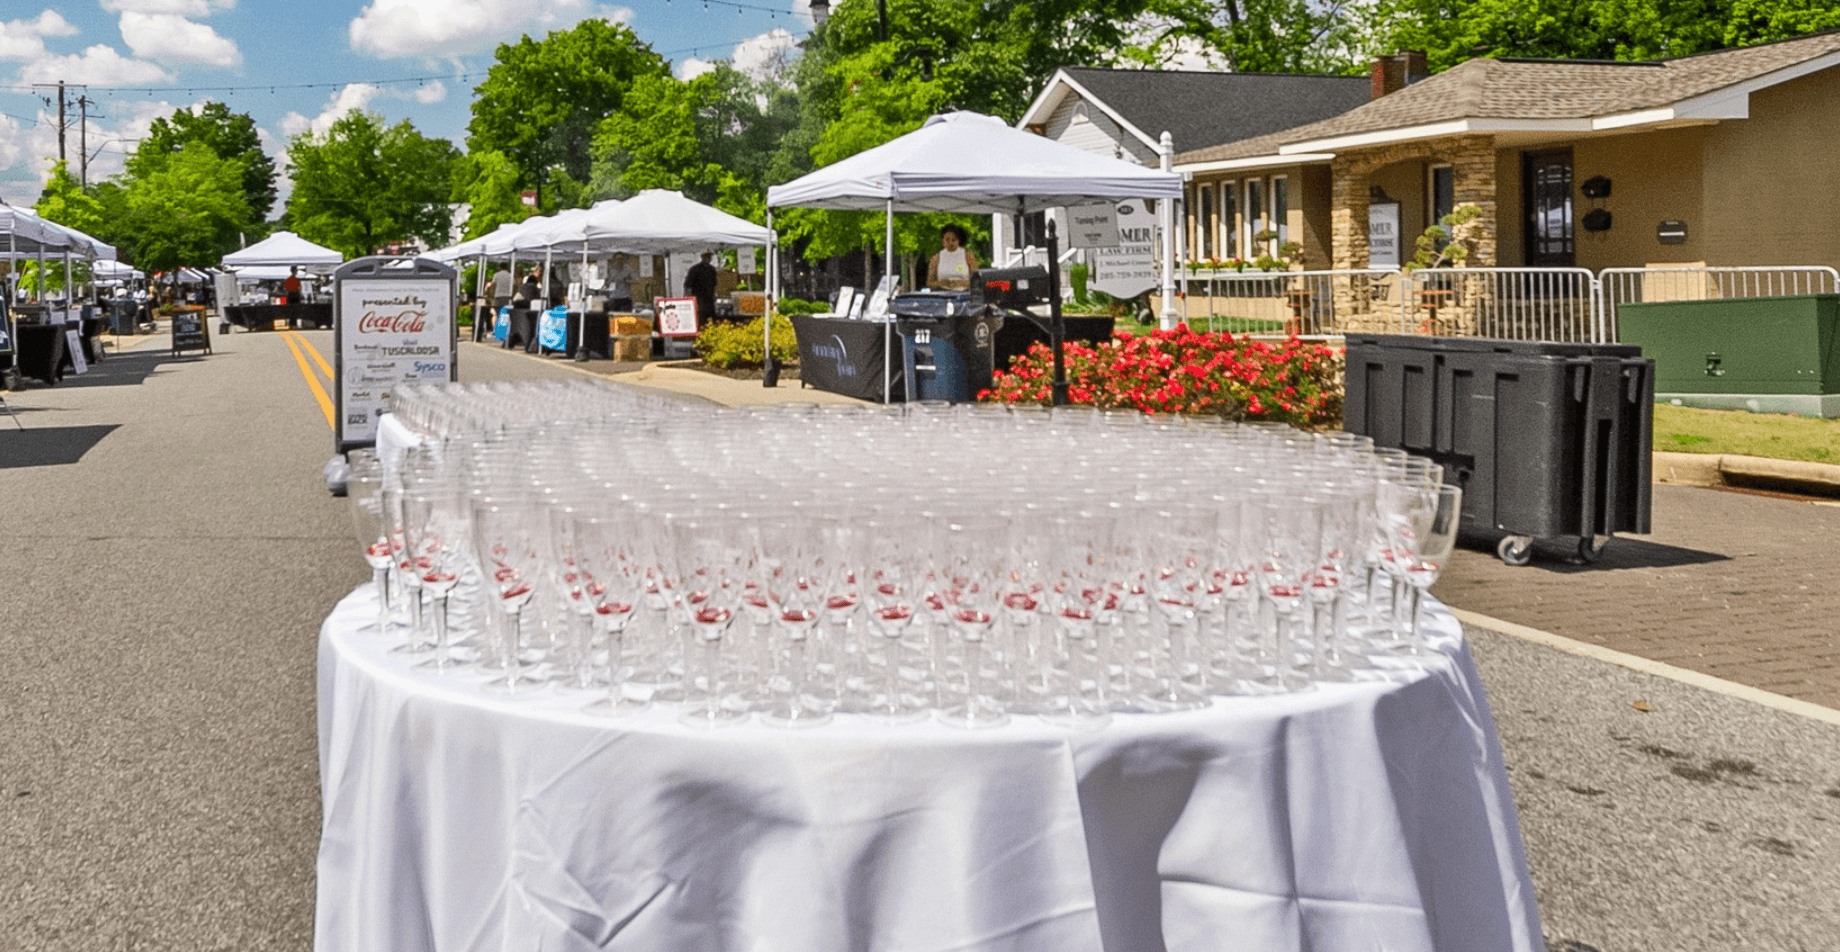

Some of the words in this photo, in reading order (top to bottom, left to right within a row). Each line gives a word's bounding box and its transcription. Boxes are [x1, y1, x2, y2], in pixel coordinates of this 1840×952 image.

[1121, 227, 1151, 242] MER
[1125, 245, 1151, 255] FIRM
[362, 295, 410, 308] presented
[413, 296, 427, 308] by
[359, 310, 428, 333] Coca-Cola
[413, 360, 446, 373] Sysco
